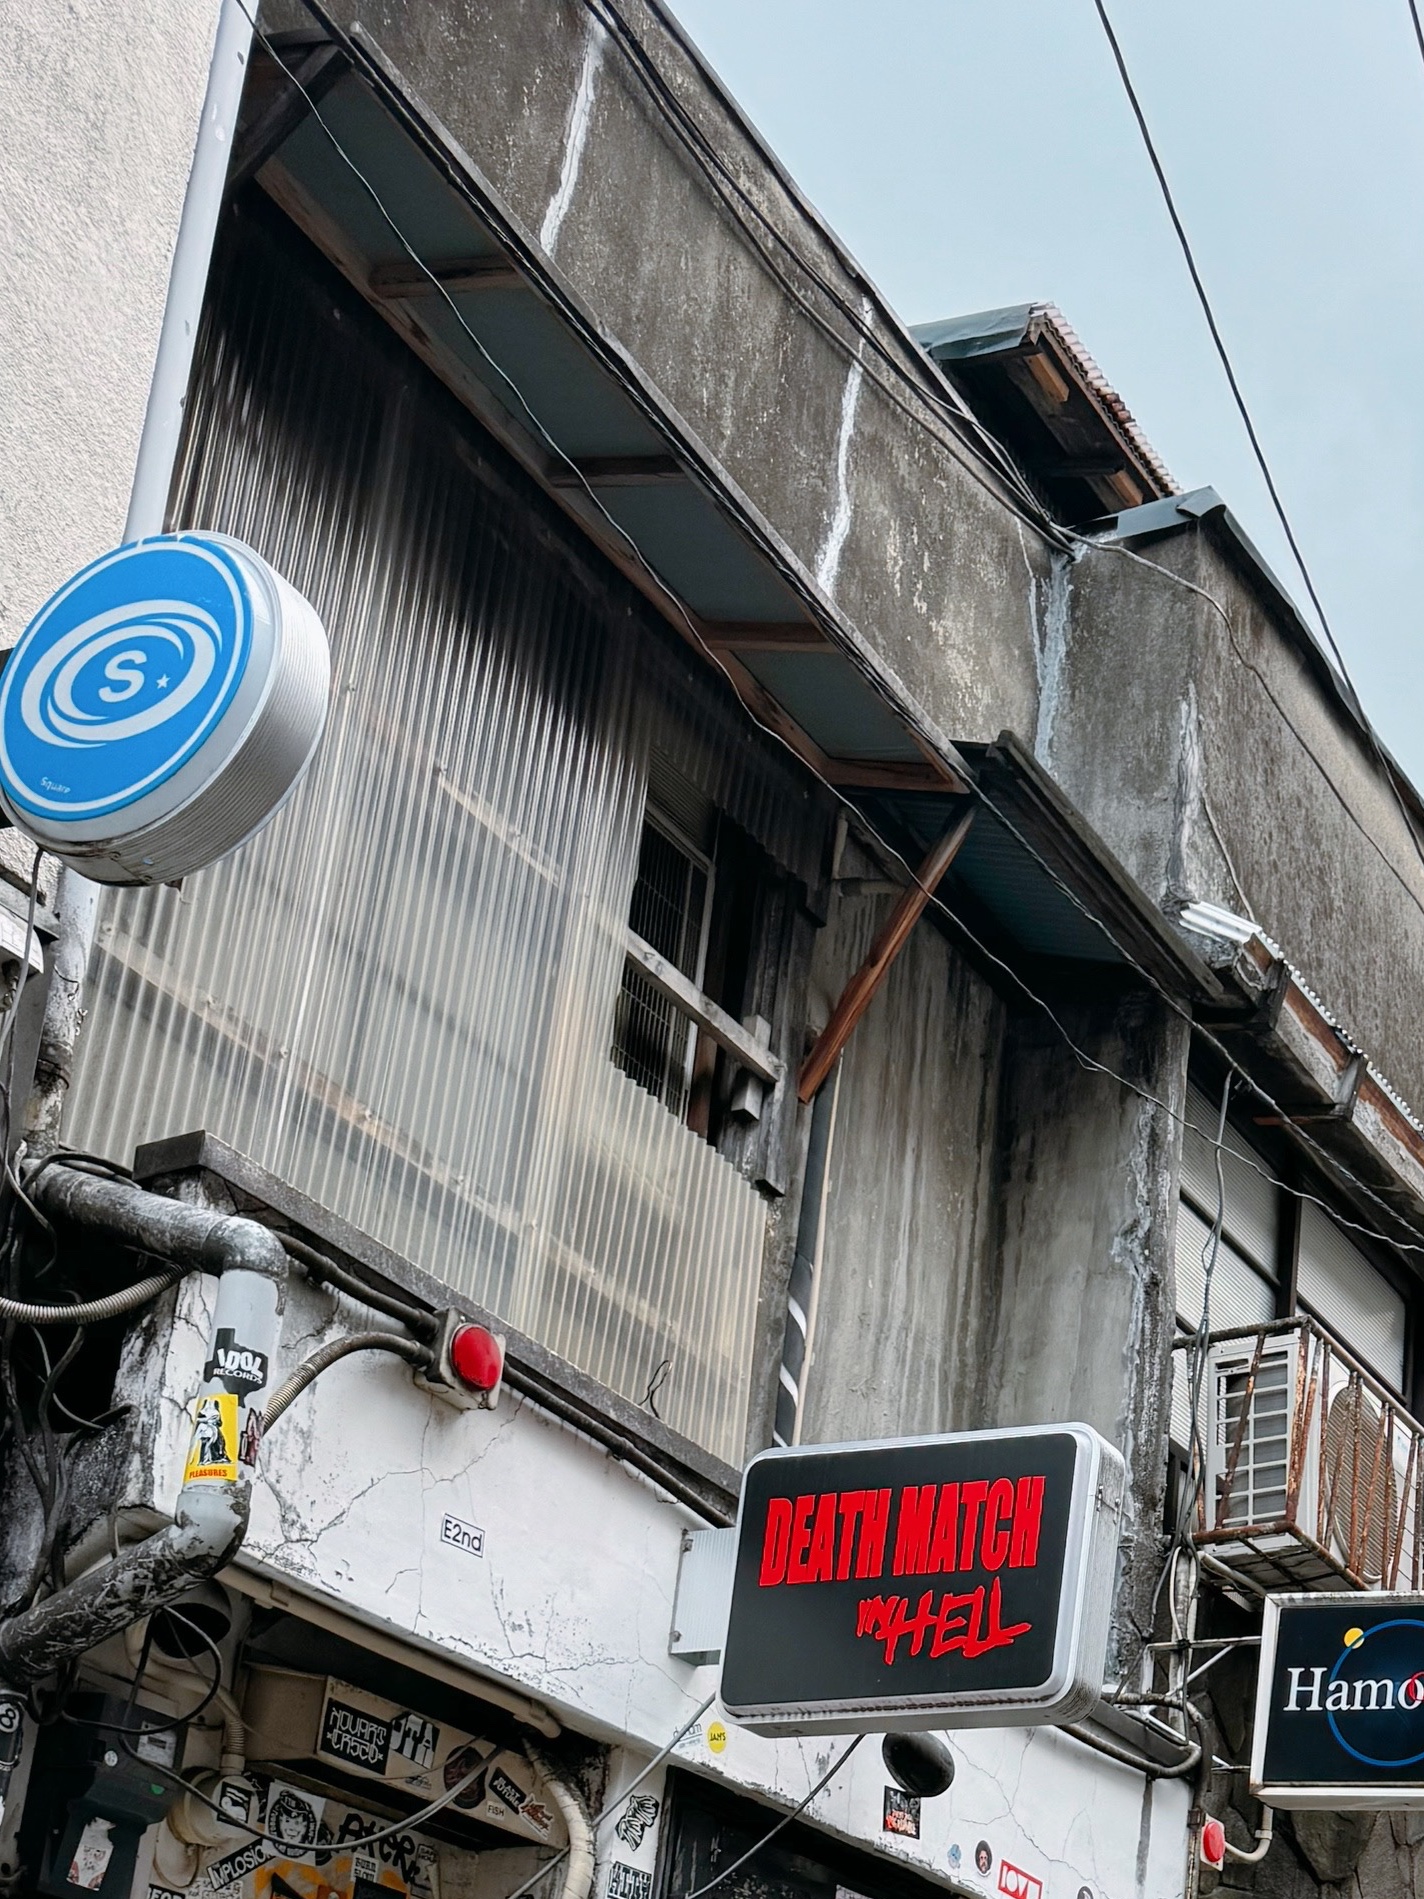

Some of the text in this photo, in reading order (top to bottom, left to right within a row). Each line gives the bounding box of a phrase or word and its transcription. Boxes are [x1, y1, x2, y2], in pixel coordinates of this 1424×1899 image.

[99, 650, 147, 703] S
[41, 776, 71, 794] Square
[213, 1368, 263, 1385] RECORDS
[217, 1348, 264, 1380] IDOL
[189, 1468, 228, 1479] PLEASURES
[443, 1520, 482, 1553] E2nd
[759, 1476, 1046, 1587] DEATH MATCH
[487, 1804, 505, 1817] FISH
